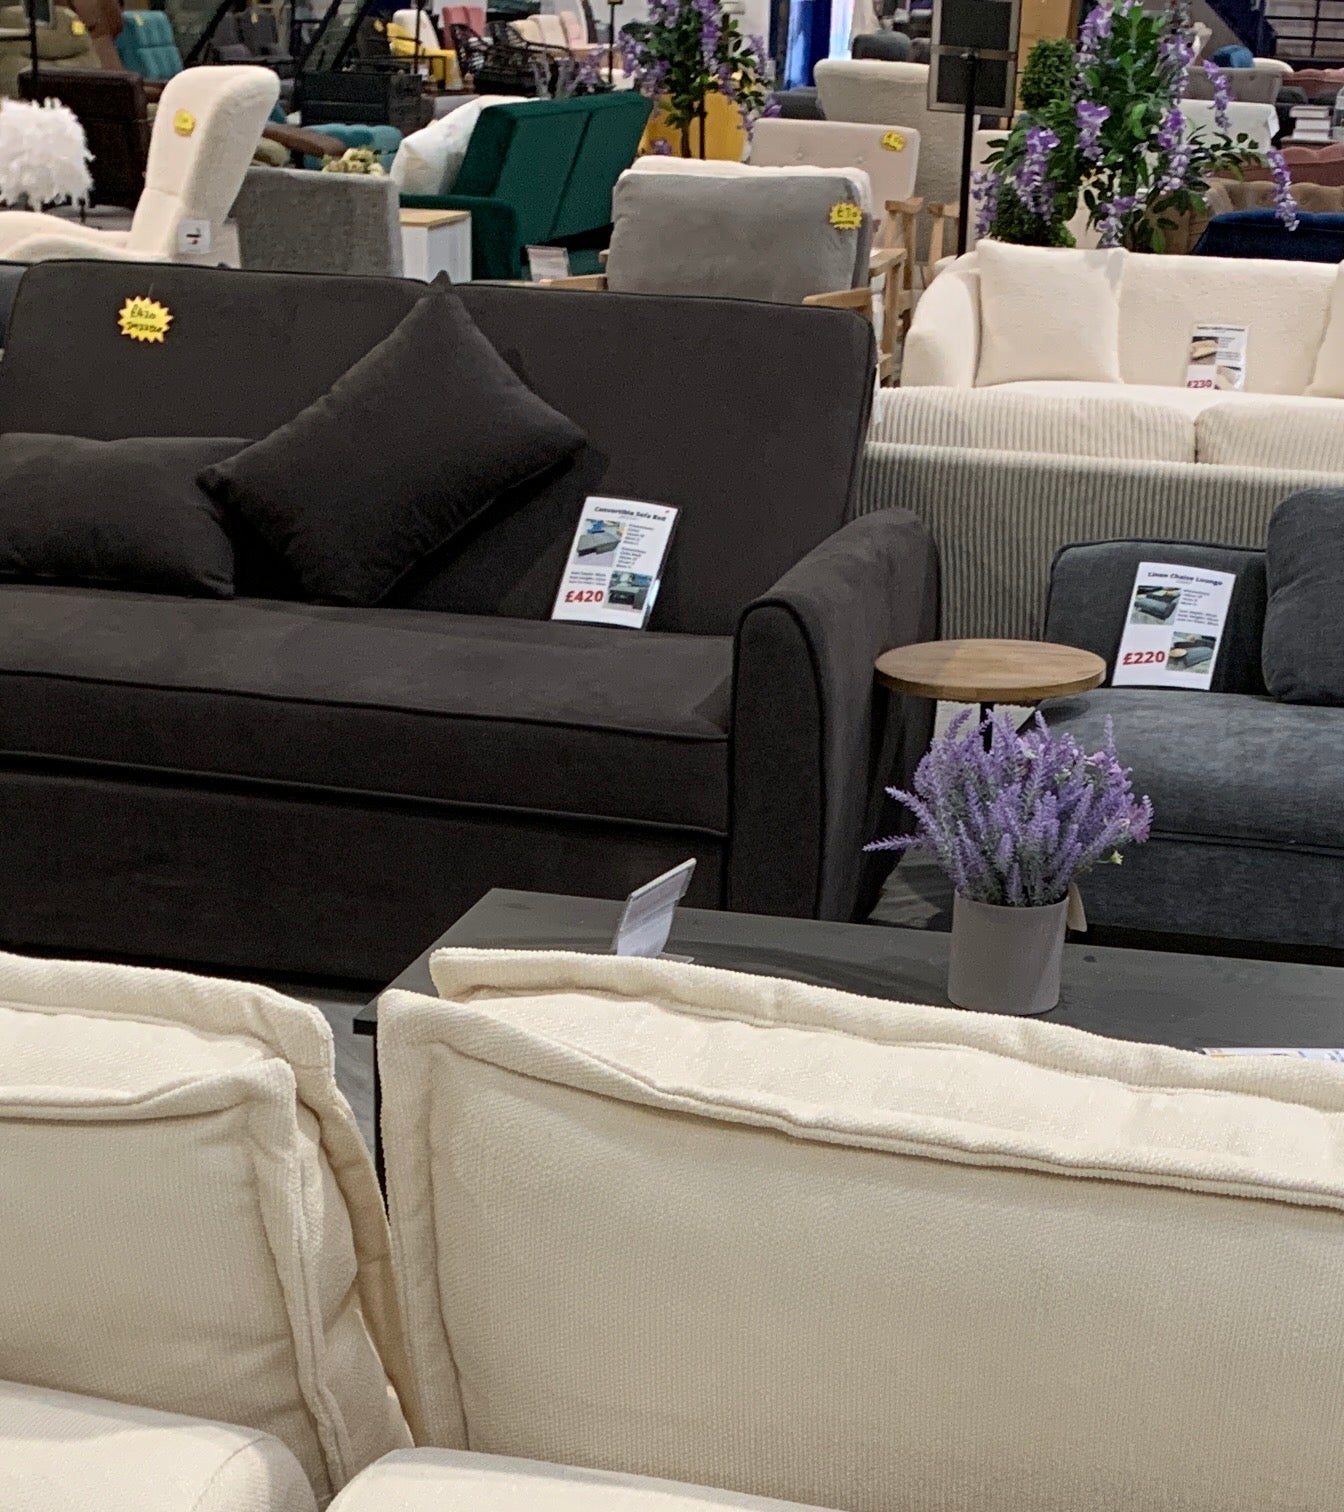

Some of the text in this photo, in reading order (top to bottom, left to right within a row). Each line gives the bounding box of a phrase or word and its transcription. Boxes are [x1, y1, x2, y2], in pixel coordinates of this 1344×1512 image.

[594, 505, 634, 517] Convertible
[1170, 572, 1195, 581] Chaise
[1196, 576, 1223, 586] Lounge
[564, 589, 604, 604] £420
[1122, 651, 1166, 666] £220
